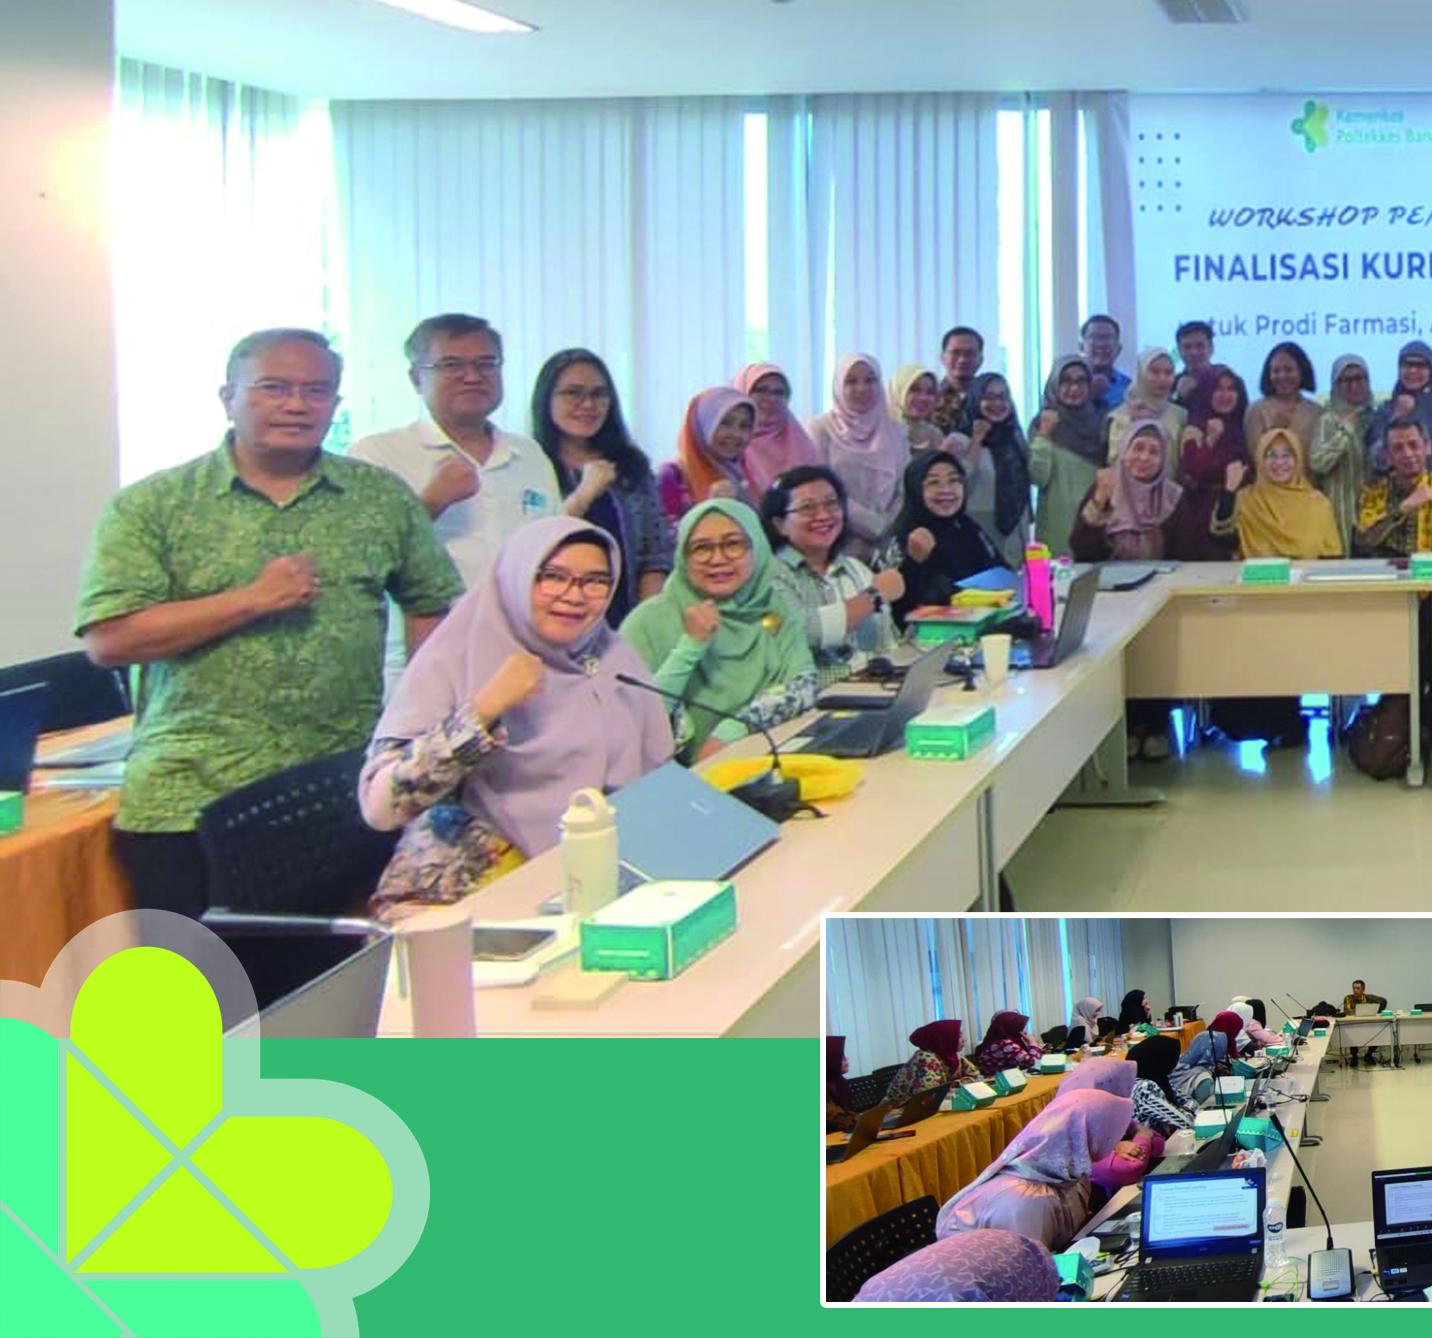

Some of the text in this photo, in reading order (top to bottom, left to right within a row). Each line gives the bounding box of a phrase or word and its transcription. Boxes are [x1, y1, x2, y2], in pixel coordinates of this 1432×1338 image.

[1208, 205, 1379, 229] WORKSHOP
[1174, 253, 1349, 282] FINALISASI
[1255, 311, 1317, 335] Prodi
[1325, 309, 1423, 336] Farmasi,
